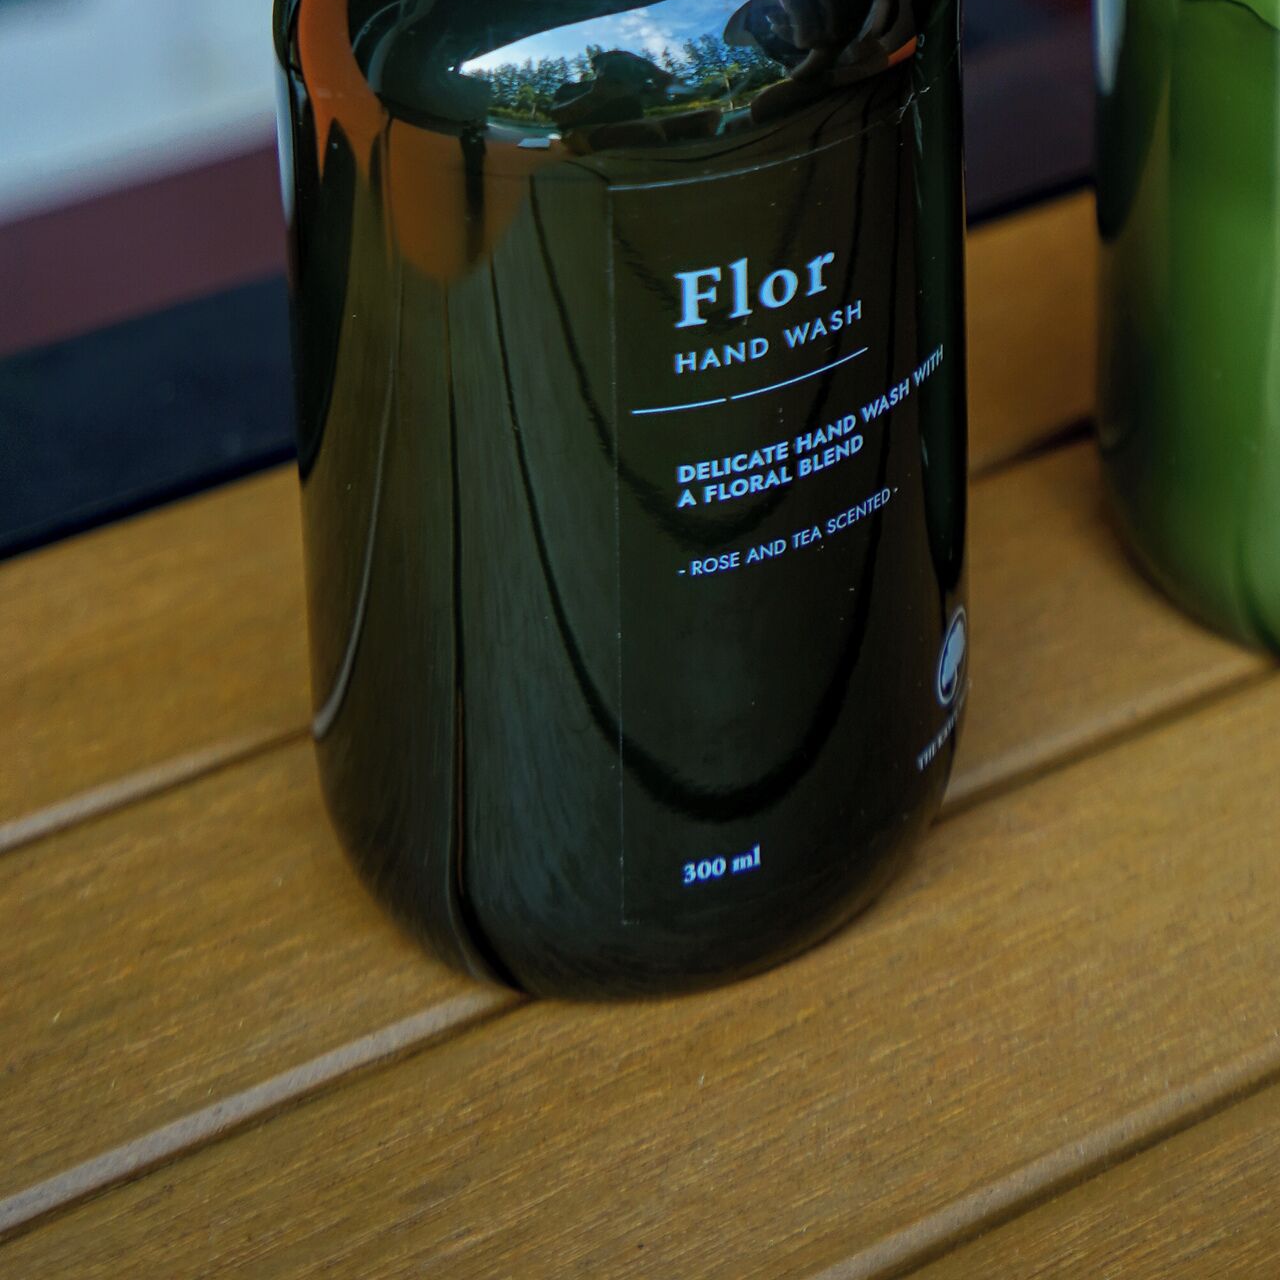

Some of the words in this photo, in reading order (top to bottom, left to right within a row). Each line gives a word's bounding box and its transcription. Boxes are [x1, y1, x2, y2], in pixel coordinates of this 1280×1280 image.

[675, 251, 834, 328] Flor
[675, 337, 769, 374] HAND
[784, 300, 862, 349] WASH
[677, 441, 788, 483] DELICATE
[796, 414, 856, 454] HAND
[861, 382, 909, 423] WASH
[914, 344, 944, 388] WITH
[678, 489, 696, 508] A
[705, 470, 792, 503] FLORAL
[800, 435, 863, 477] BLEND
[692, 552, 740, 576] ROSE
[746, 539, 786, 564] AND
[792, 527, 822, 548] TEA
[828, 488, 890, 533] SCENTED
[684, 857, 725, 883] 300
[732, 845, 761, 873] ml
